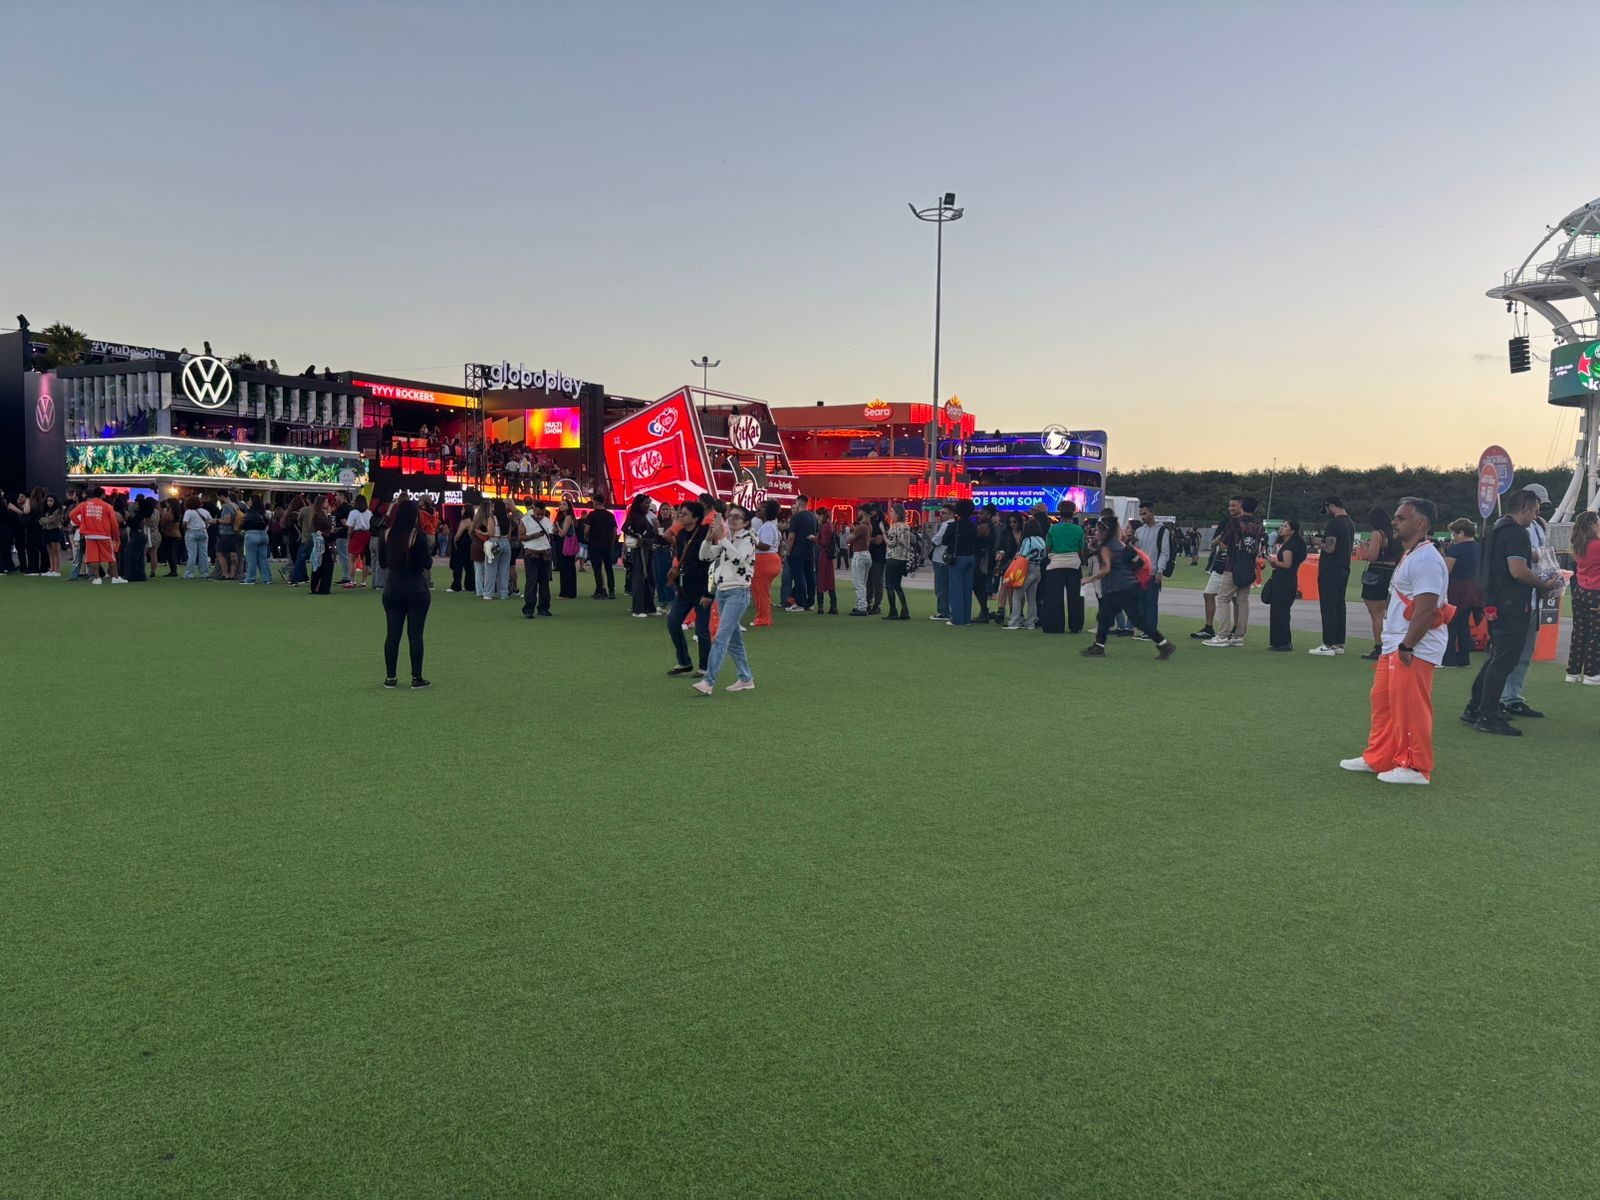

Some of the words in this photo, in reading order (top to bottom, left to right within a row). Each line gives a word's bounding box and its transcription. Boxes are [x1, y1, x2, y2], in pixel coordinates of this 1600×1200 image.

[185, 357, 230, 404] VW
[490, 360, 583, 399] globoplay
[367, 384, 395, 397] EYYY
[396, 388, 435, 401] ROCKERS
[864, 407, 890, 416] Seara
[732, 416, 760, 449] KitKat
[970, 445, 1007, 454] Prudential
[632, 451, 661, 478] KitKat
[982, 496, 989, 506] E
[991, 496, 1015, 506] BOM
[1017, 496, 1043, 506] SOM
